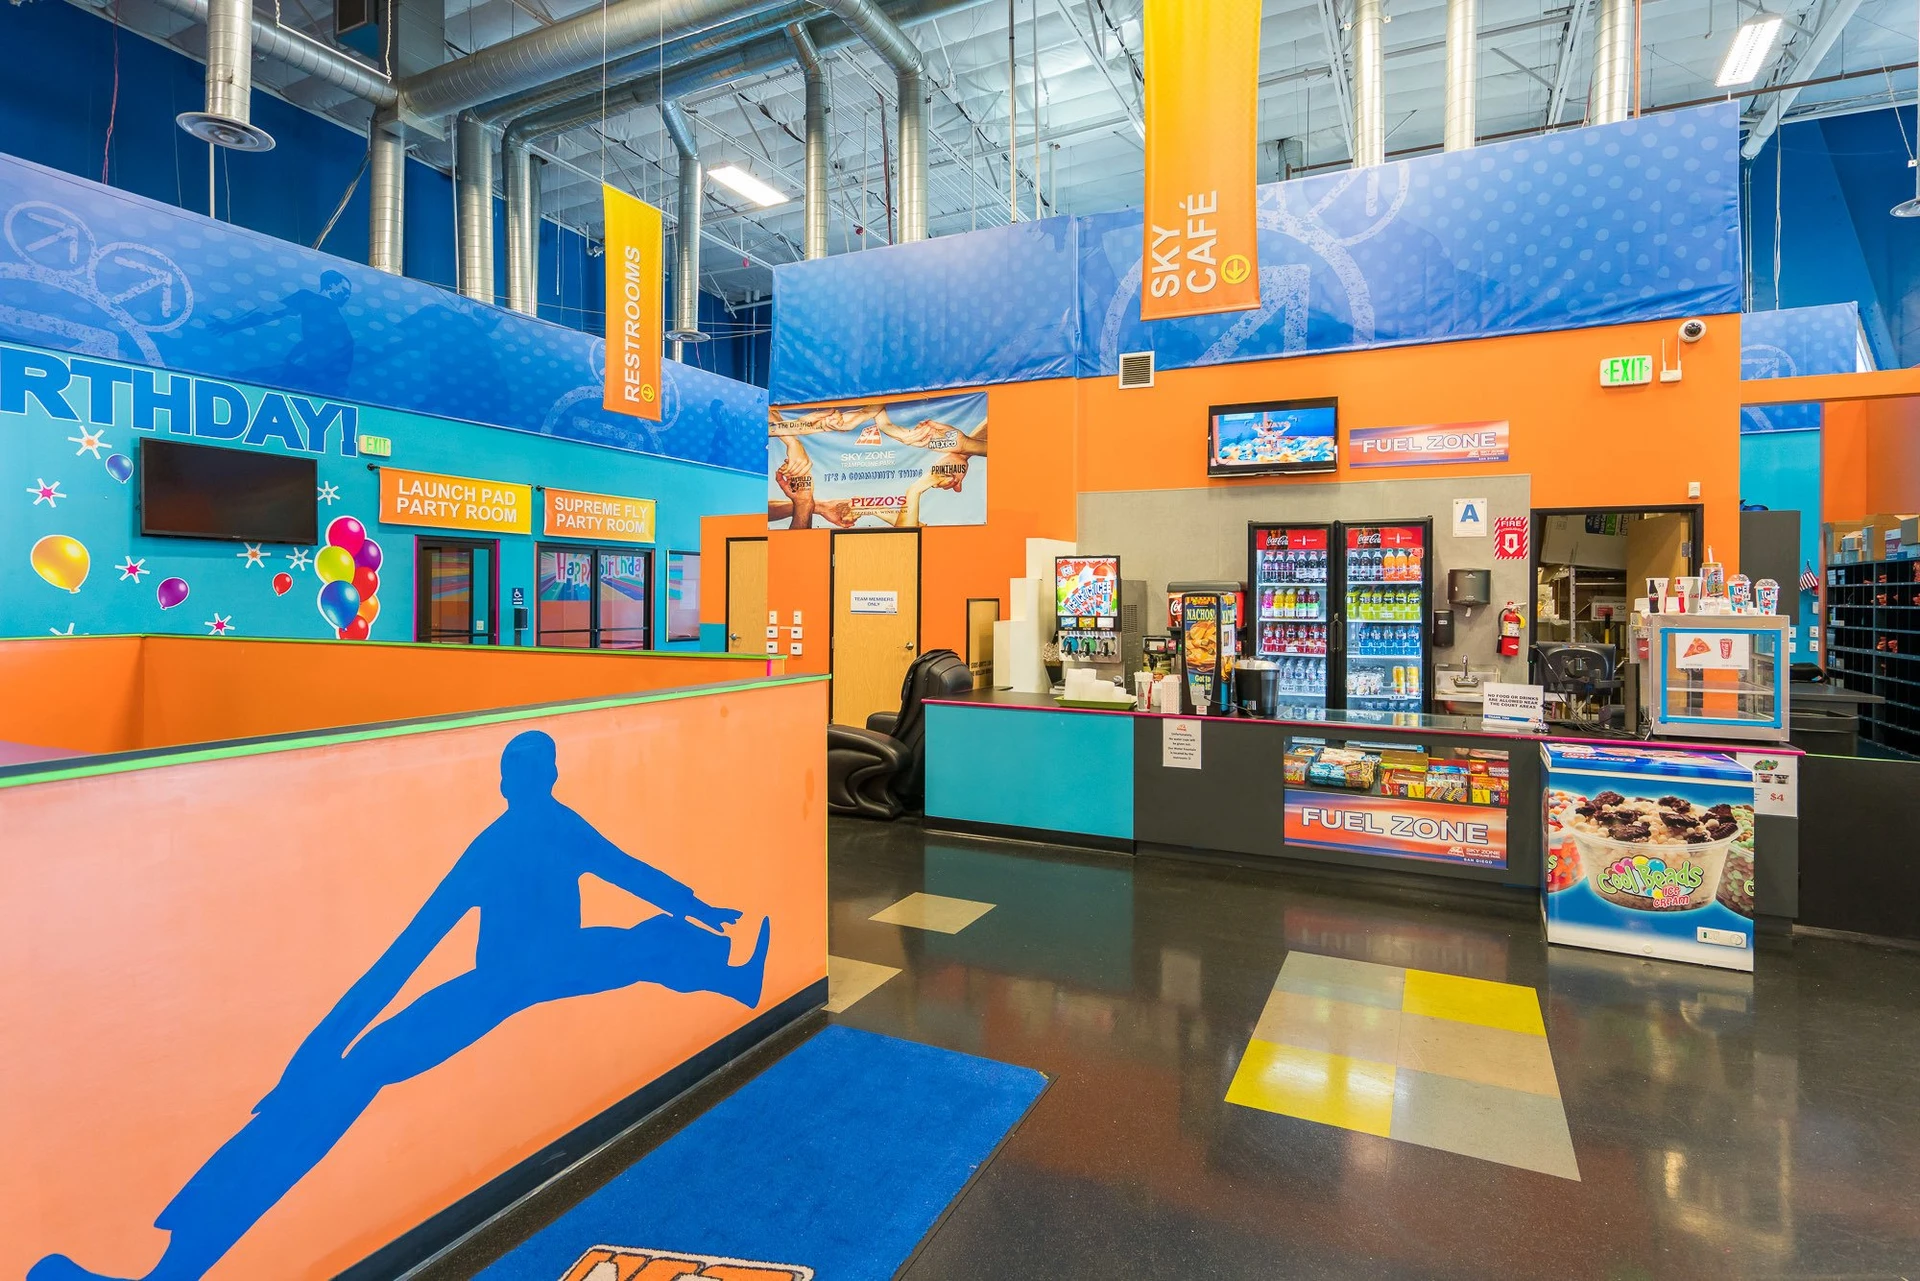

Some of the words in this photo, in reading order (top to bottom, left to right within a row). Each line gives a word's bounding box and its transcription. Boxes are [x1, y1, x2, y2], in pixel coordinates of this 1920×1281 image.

[1178, 190, 1217, 294] CAFÉ
[1151, 224, 1181, 298] SKY
[624, 245, 641, 403] RESTROOMS
[1610, 357, 1646, 382] EXIT
[366, 437, 387, 454] EXIT
[928, 440, 957, 449] MEXICO
[1362, 437, 1422, 453] FUEL
[1427, 431, 1496, 450] ZONE
[841, 453, 862, 461] SKY
[865, 450, 895, 460] ZONE
[824, 473, 839, 482] IT'S
[841, 472, 847, 481] A
[849, 470, 895, 480] COMMUNITY
[899, 469, 923, 479] THING
[398, 478, 476, 502] LAUNCH
[481, 488, 516, 506] PAD
[851, 496, 907, 507] PIZZO'S
[397, 497, 461, 518] PARTY
[466, 504, 517, 523] ROOM
[555, 497, 621, 516] SUPREME
[625, 504, 648, 519] FLY
[1460, 504, 1479, 522] A
[556, 513, 603, 530] PARTY
[606, 518, 645, 533] ROOM
[1770, 793, 1784, 801] $4
[1302, 807, 1384, 834] FUEL
[1391, 816, 1489, 844] ZONE
[1597, 865, 1640, 894] Cool
[1634, 861, 1704, 890] Beads
[1662, 886, 1680, 897] ICE
[1652, 896, 1690, 909] CREAM
